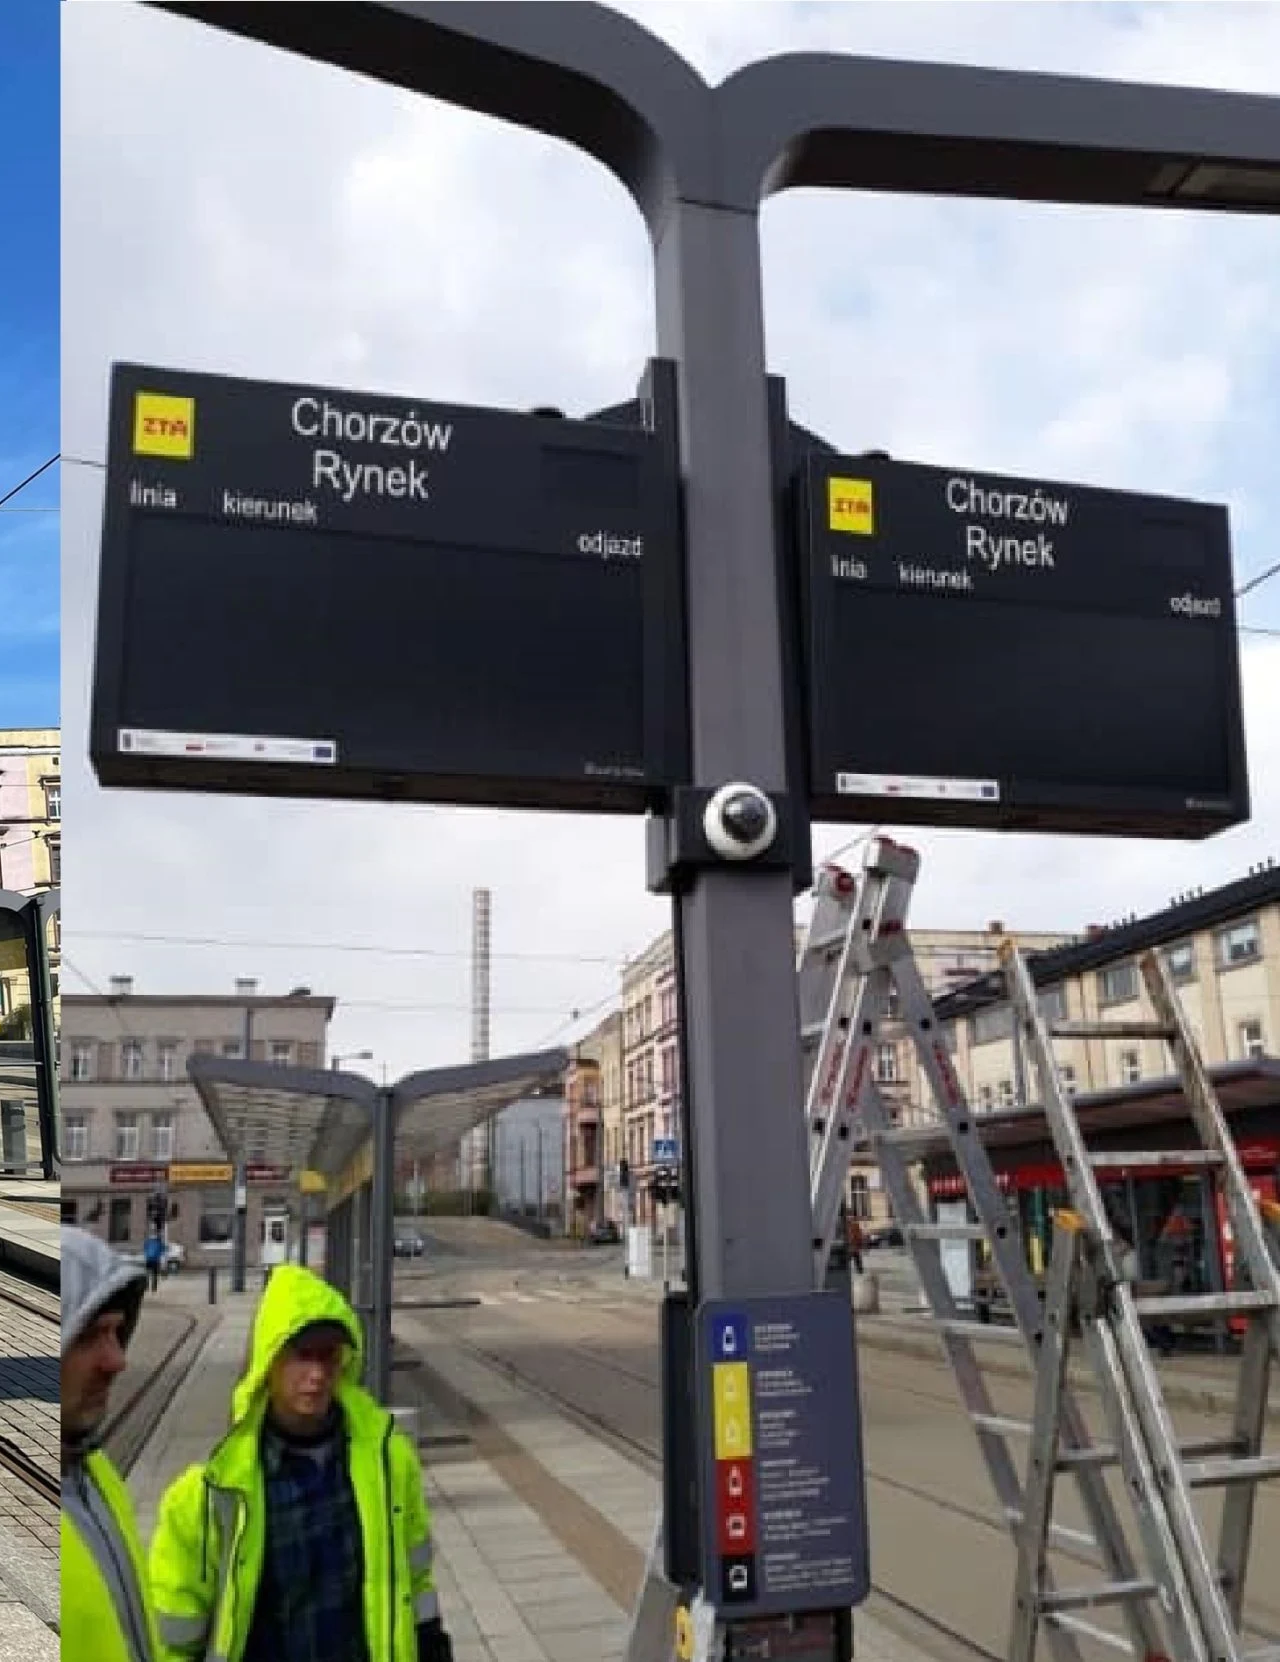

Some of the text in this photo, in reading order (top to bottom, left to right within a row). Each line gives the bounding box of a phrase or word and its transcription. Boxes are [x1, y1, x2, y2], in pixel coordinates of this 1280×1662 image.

[291, 397, 453, 451] Chorzów
[312, 450, 428, 501] Rynek
[223, 490, 318, 524] kierunek
[947, 478, 1068, 526] Chorzów
[967, 525, 1054, 570] Rynek
